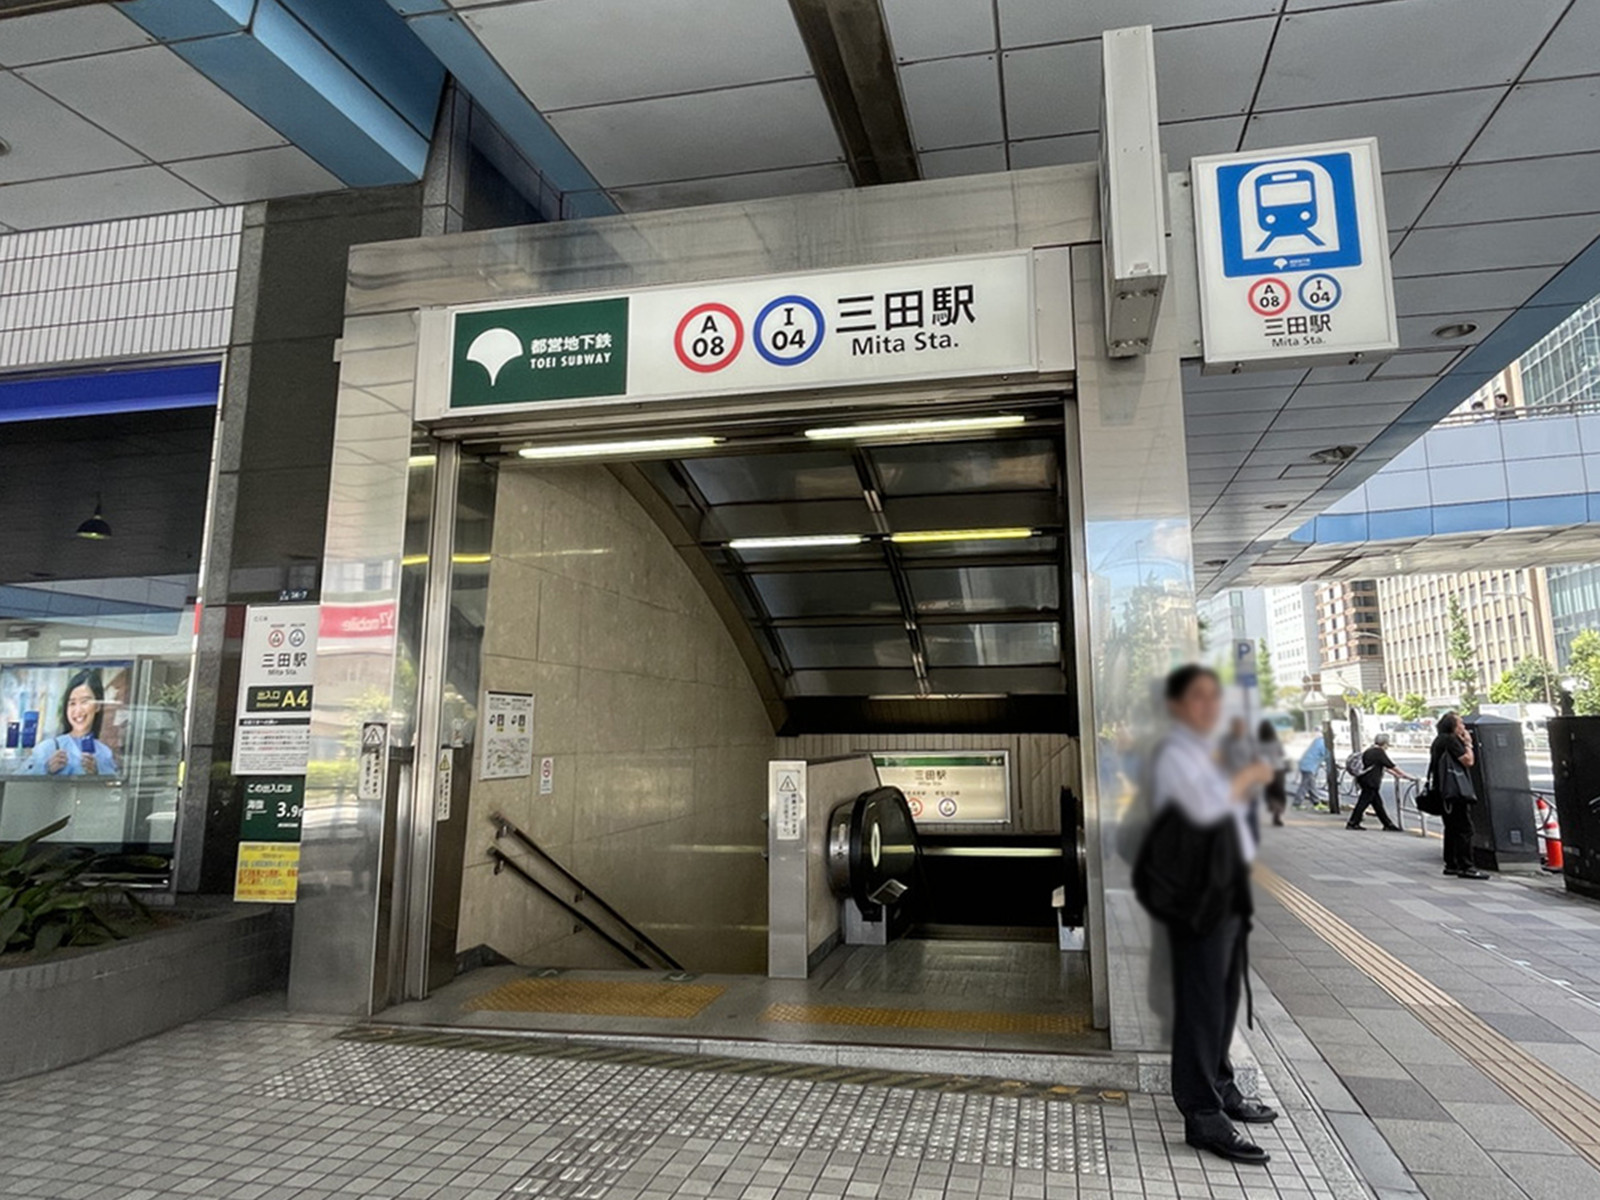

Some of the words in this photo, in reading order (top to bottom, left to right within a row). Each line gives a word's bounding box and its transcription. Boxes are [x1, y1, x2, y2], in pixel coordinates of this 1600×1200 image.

[1264, 284, 1274, 294] A
[1316, 280, 1322, 290] I
[1260, 296, 1280, 308] 08
[1309, 292, 1330, 304] 04
[784, 307, 794, 326] I
[835, 284, 976, 334] 三田駅
[700, 315, 718, 334] A
[1264, 313, 1332, 337] 三田駅
[530, 333, 612, 355] 都営地下鉄
[692, 336, 725, 358] 08
[771, 329, 806, 351] 04
[852, 334, 906, 356] Mita
[914, 332, 959, 352] Sta.
[1271, 338, 1299, 347] Mita
[530, 356, 556, 369] TOEI
[561, 352, 612, 368] SUBWAY
[262, 652, 308, 668] 三田駅
[1238, 642, 1250, 659] P
[281, 689, 309, 708] A4
